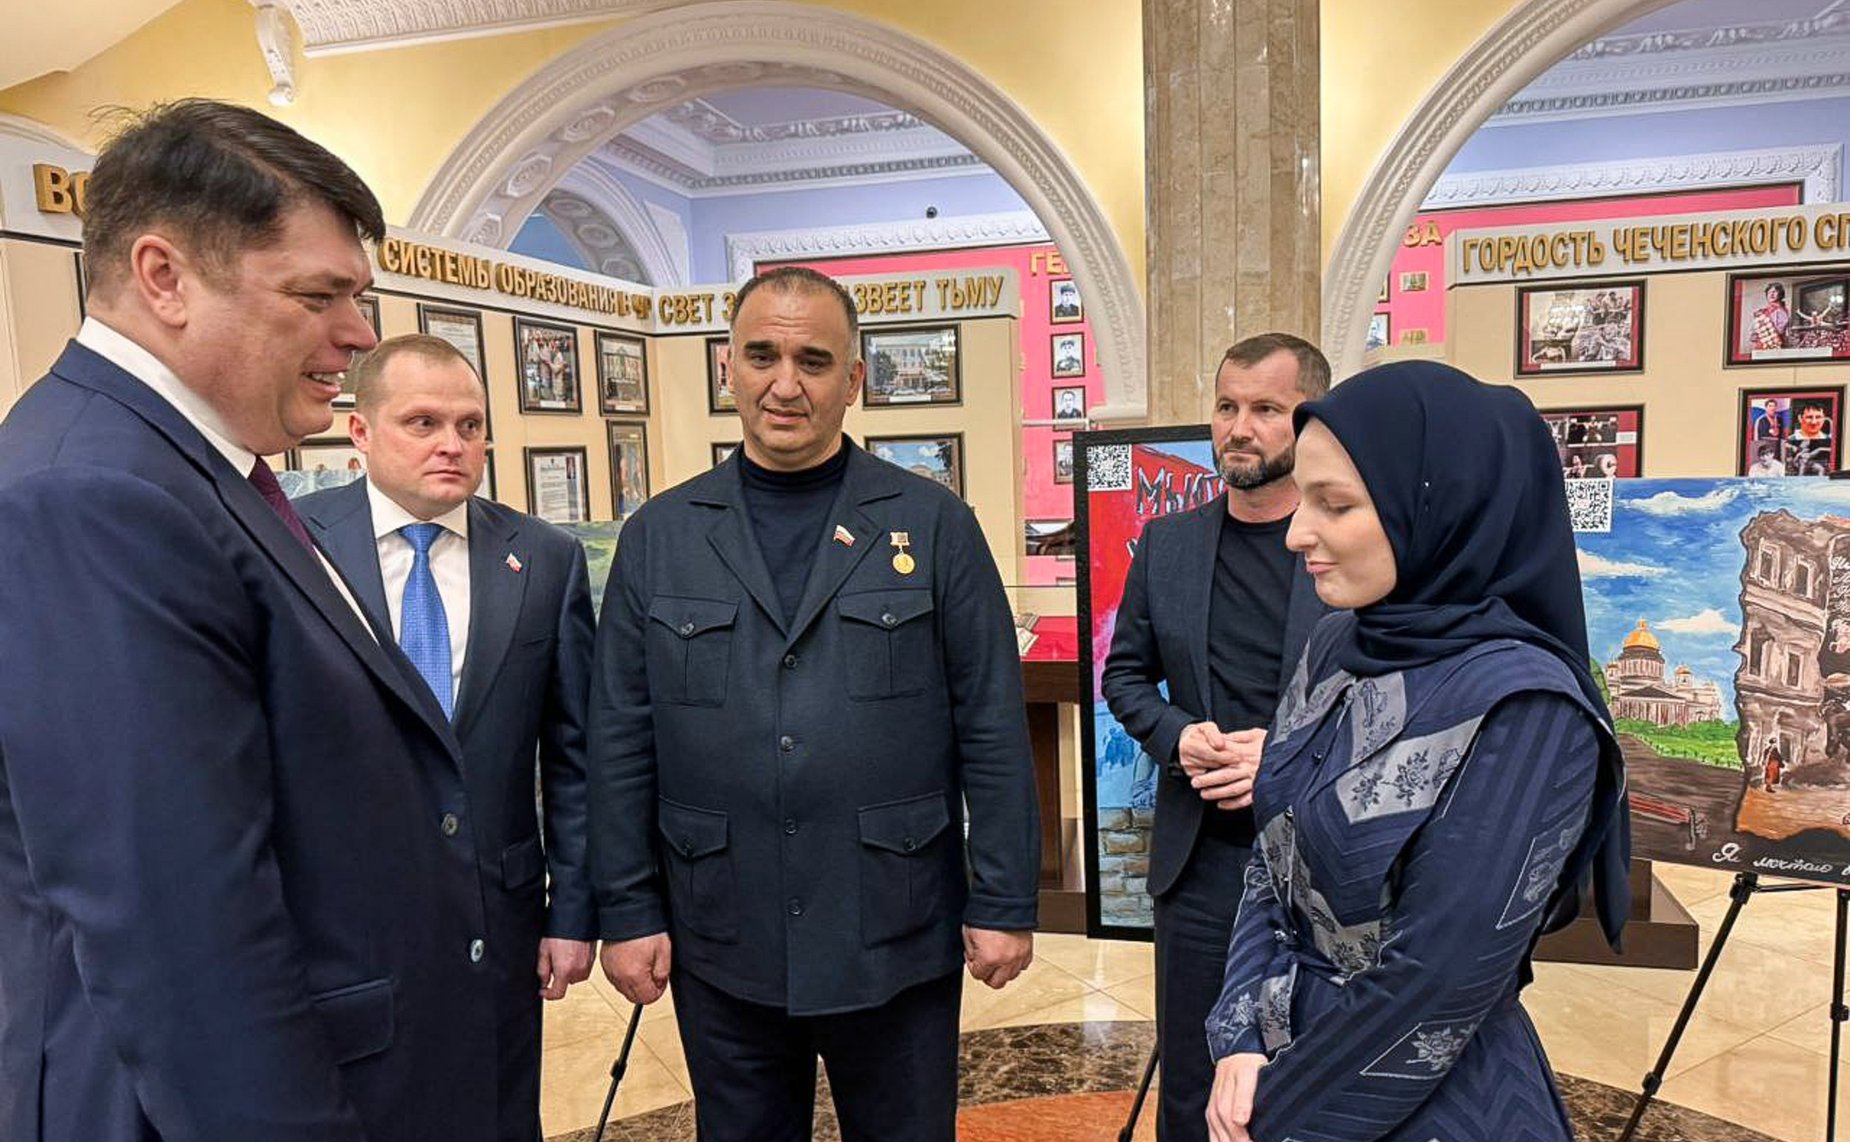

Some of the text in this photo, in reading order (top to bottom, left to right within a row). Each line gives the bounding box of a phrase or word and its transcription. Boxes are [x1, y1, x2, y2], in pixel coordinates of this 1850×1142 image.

[377, 239, 491, 289] СИСТЕМЫ
[494, 262, 617, 315] ОБРАЗОВАНИЯ
[1462, 230, 1606, 277] ГОРДОСТЬ
[1613, 213, 1808, 264] ЧЕЧЕНСКОГО
[658, 292, 715, 325] СВЕТ
[936, 275, 1004, 311] ТЬМУ
